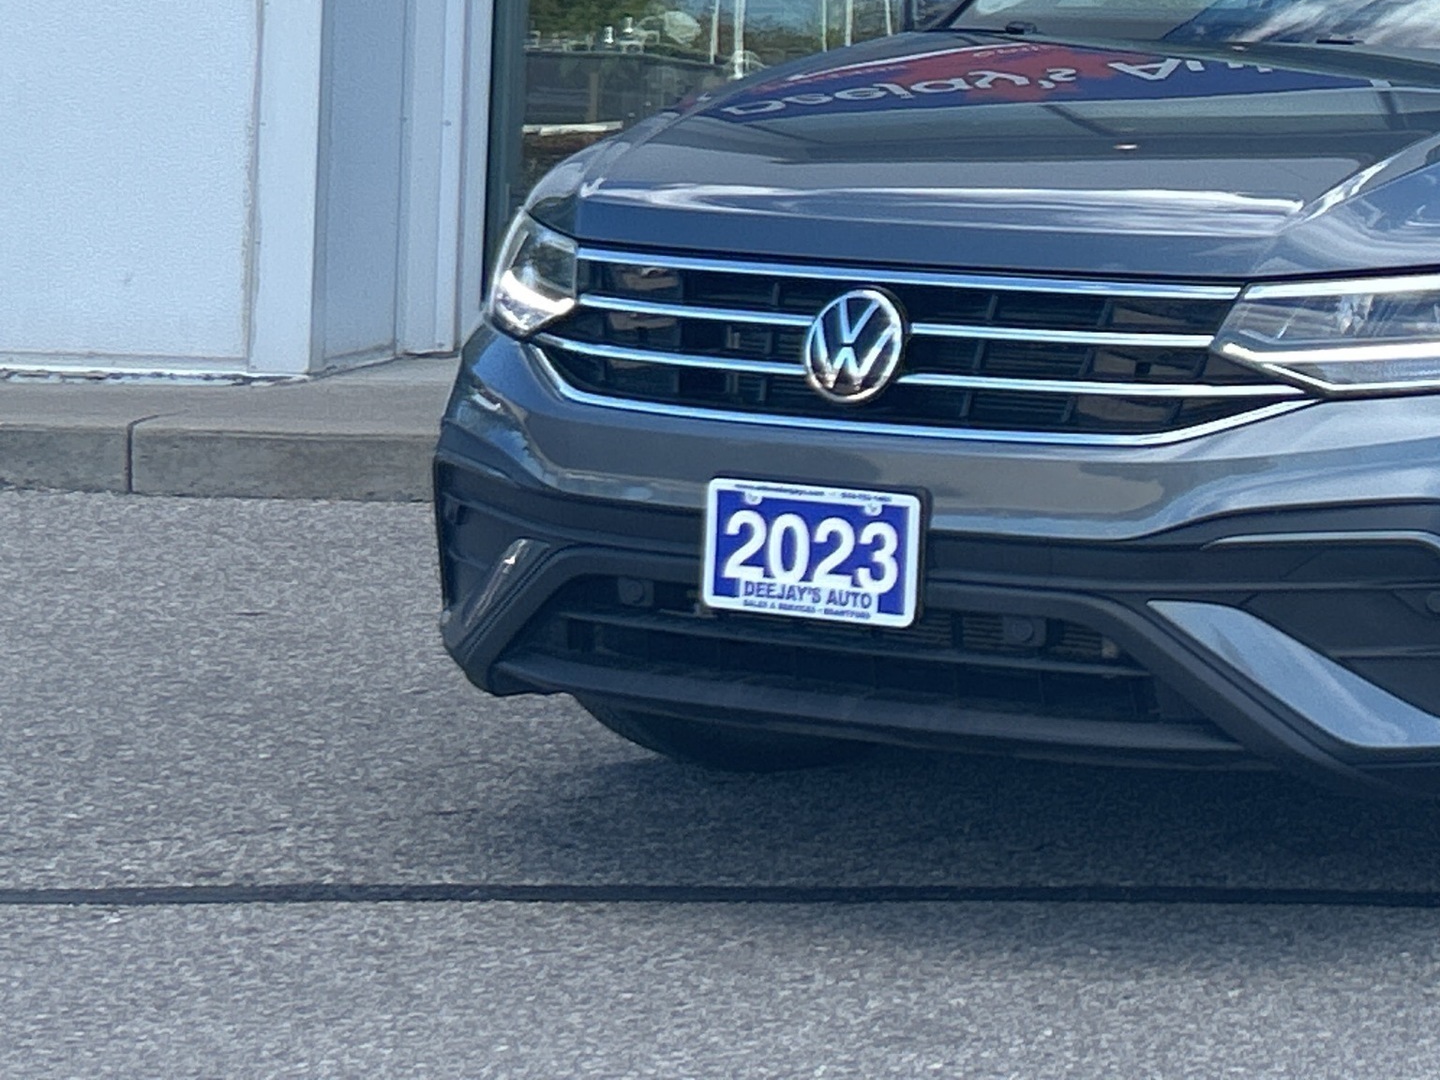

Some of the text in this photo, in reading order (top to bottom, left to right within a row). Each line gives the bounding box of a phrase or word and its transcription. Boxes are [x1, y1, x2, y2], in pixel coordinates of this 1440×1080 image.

[722, 510, 898, 594] 2023
[743, 580, 873, 610] DEEJAY'S AUTO
